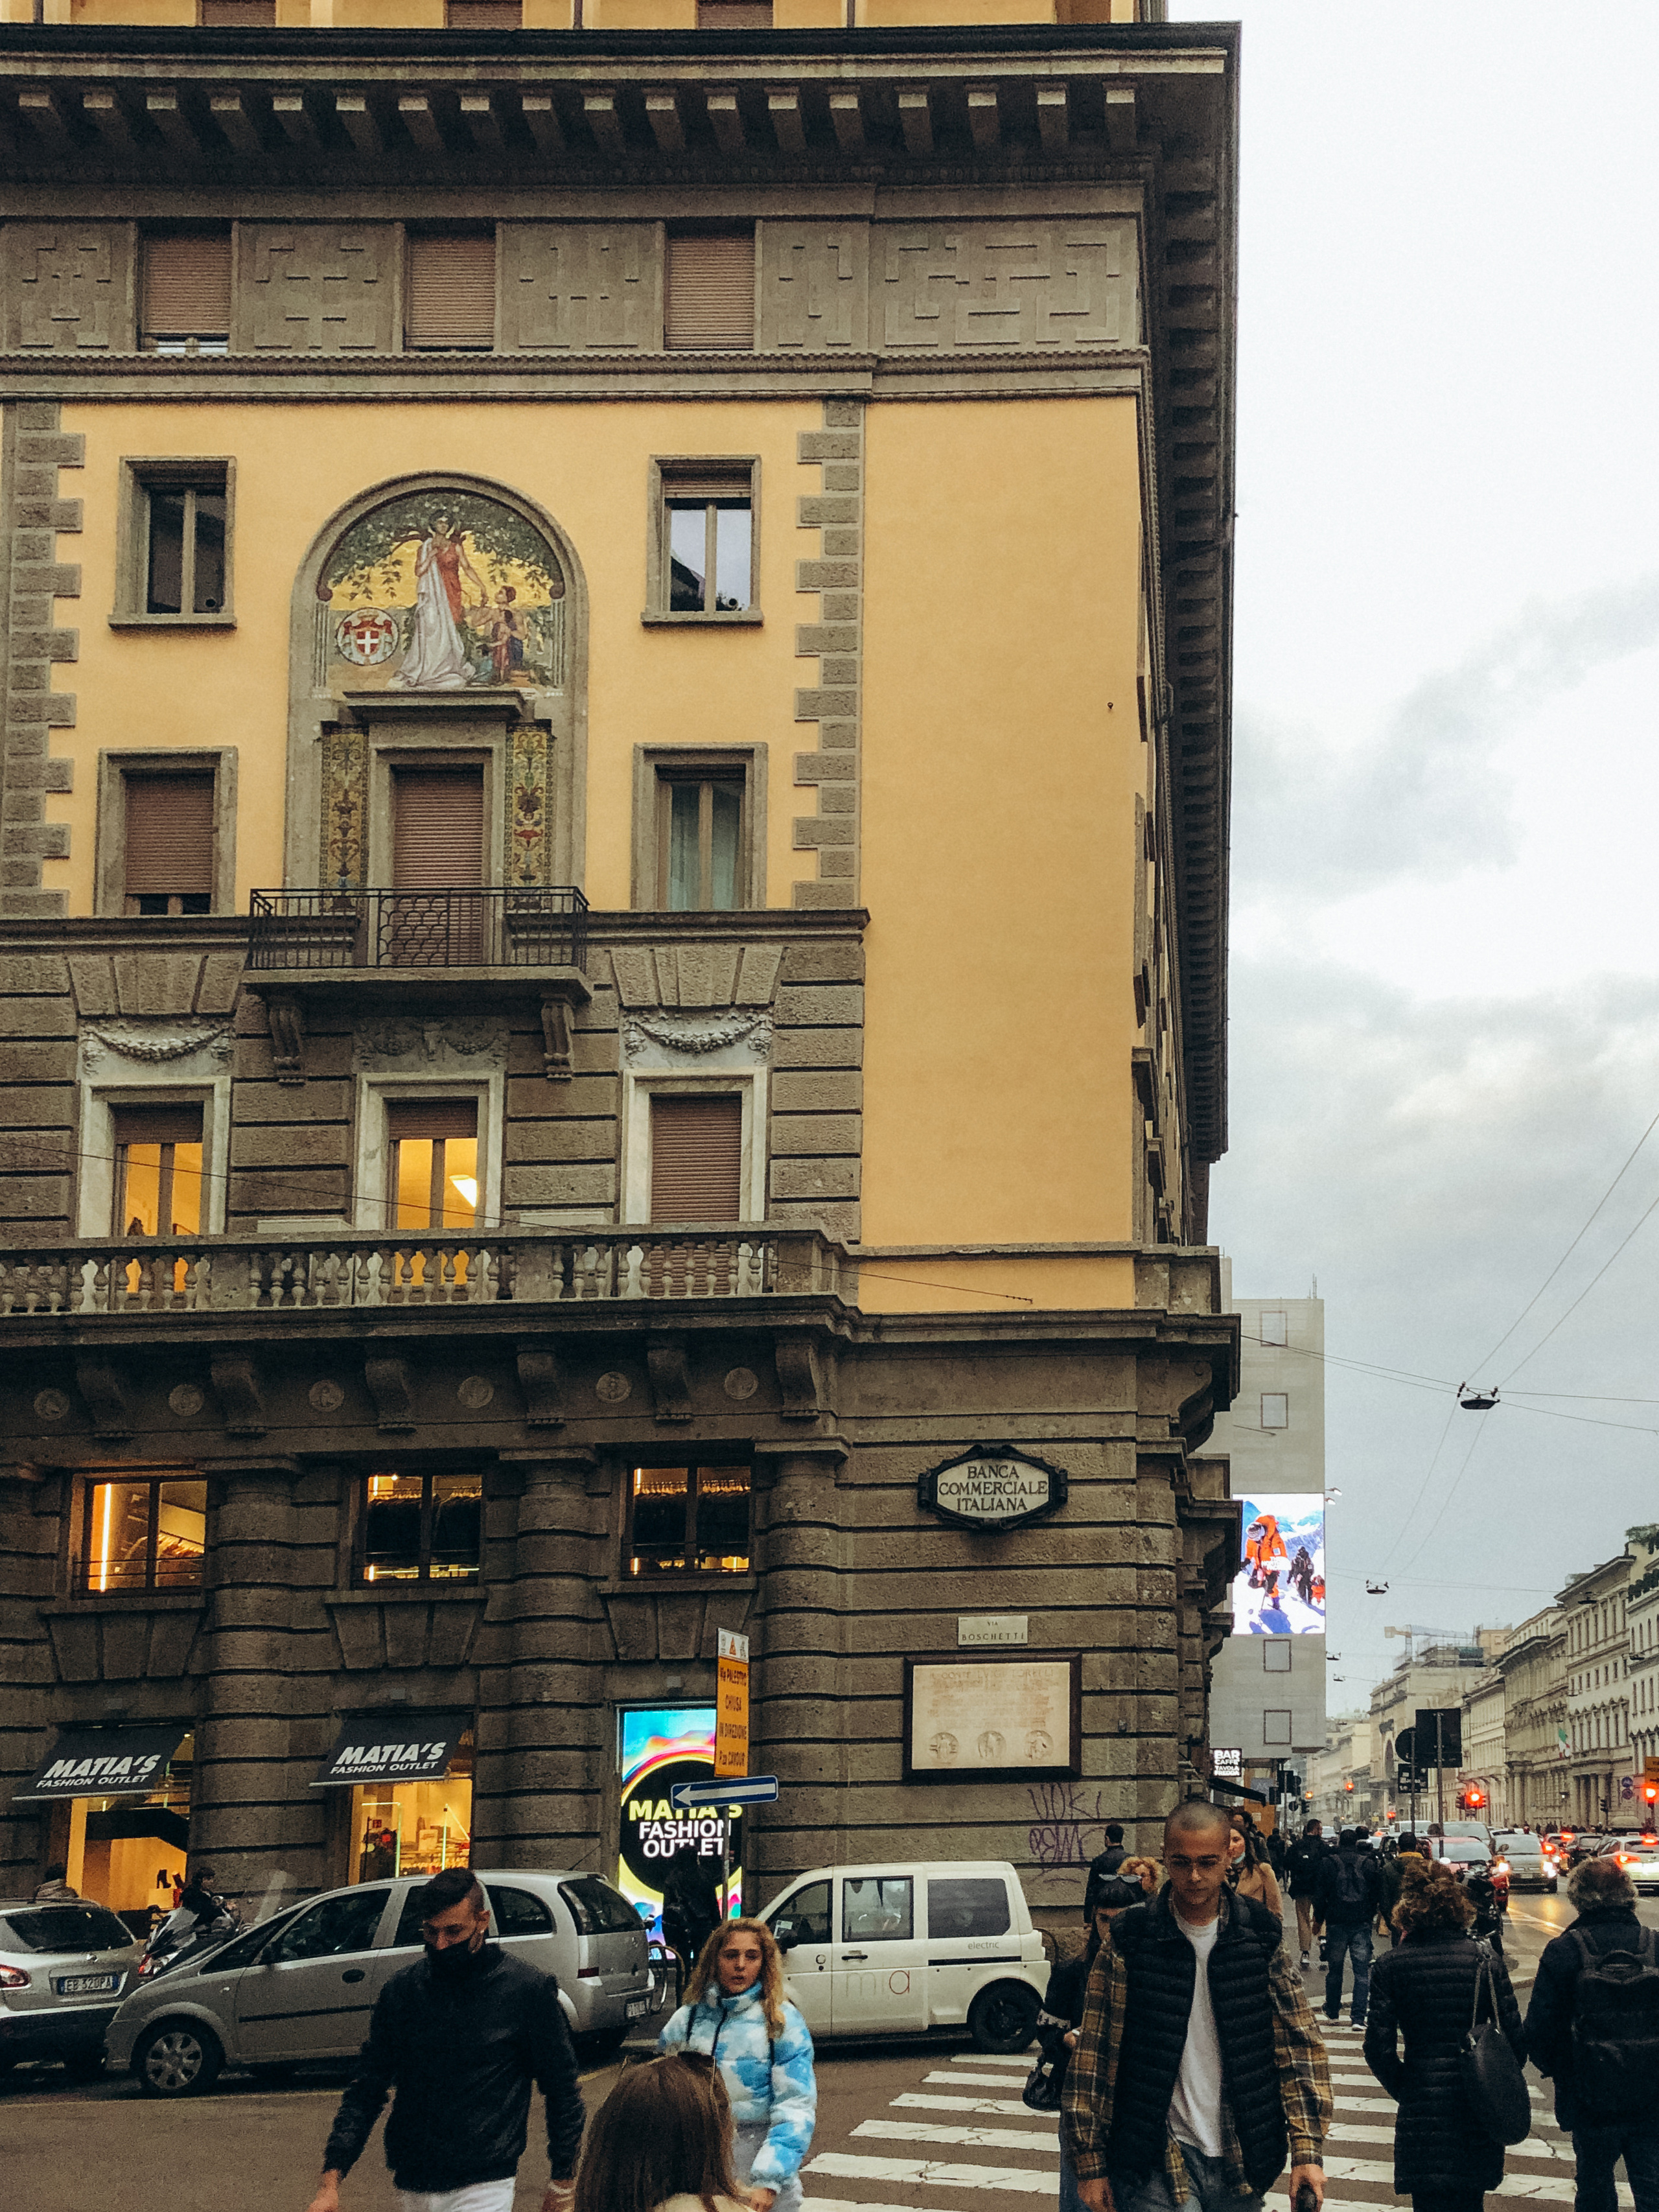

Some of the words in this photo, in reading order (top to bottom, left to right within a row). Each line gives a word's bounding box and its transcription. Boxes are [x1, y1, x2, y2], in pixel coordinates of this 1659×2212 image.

[968, 1465, 1020, 1479] BANCA
[939, 1481, 1049, 1495] COMMERCIALE
[957, 1497, 1028, 1511] ITALIANA
[962, 1633, 1024, 1641] BOSCHETTI
[336, 1741, 447, 1765] MATIA'S
[1214, 1750, 1240, 1760] BAR
[43, 1754, 162, 1778] MATIA'S
[330, 1764, 386, 1775] FASHION
[389, 1761, 439, 1771] OUTLET
[36, 1778, 95, 1788] FASHION
[98, 1775, 149, 1785] OUTLET
[639, 1819, 731, 1839] FASHION
[968, 1941, 1000, 1950] electric
[846, 1963, 911, 1996] mia
